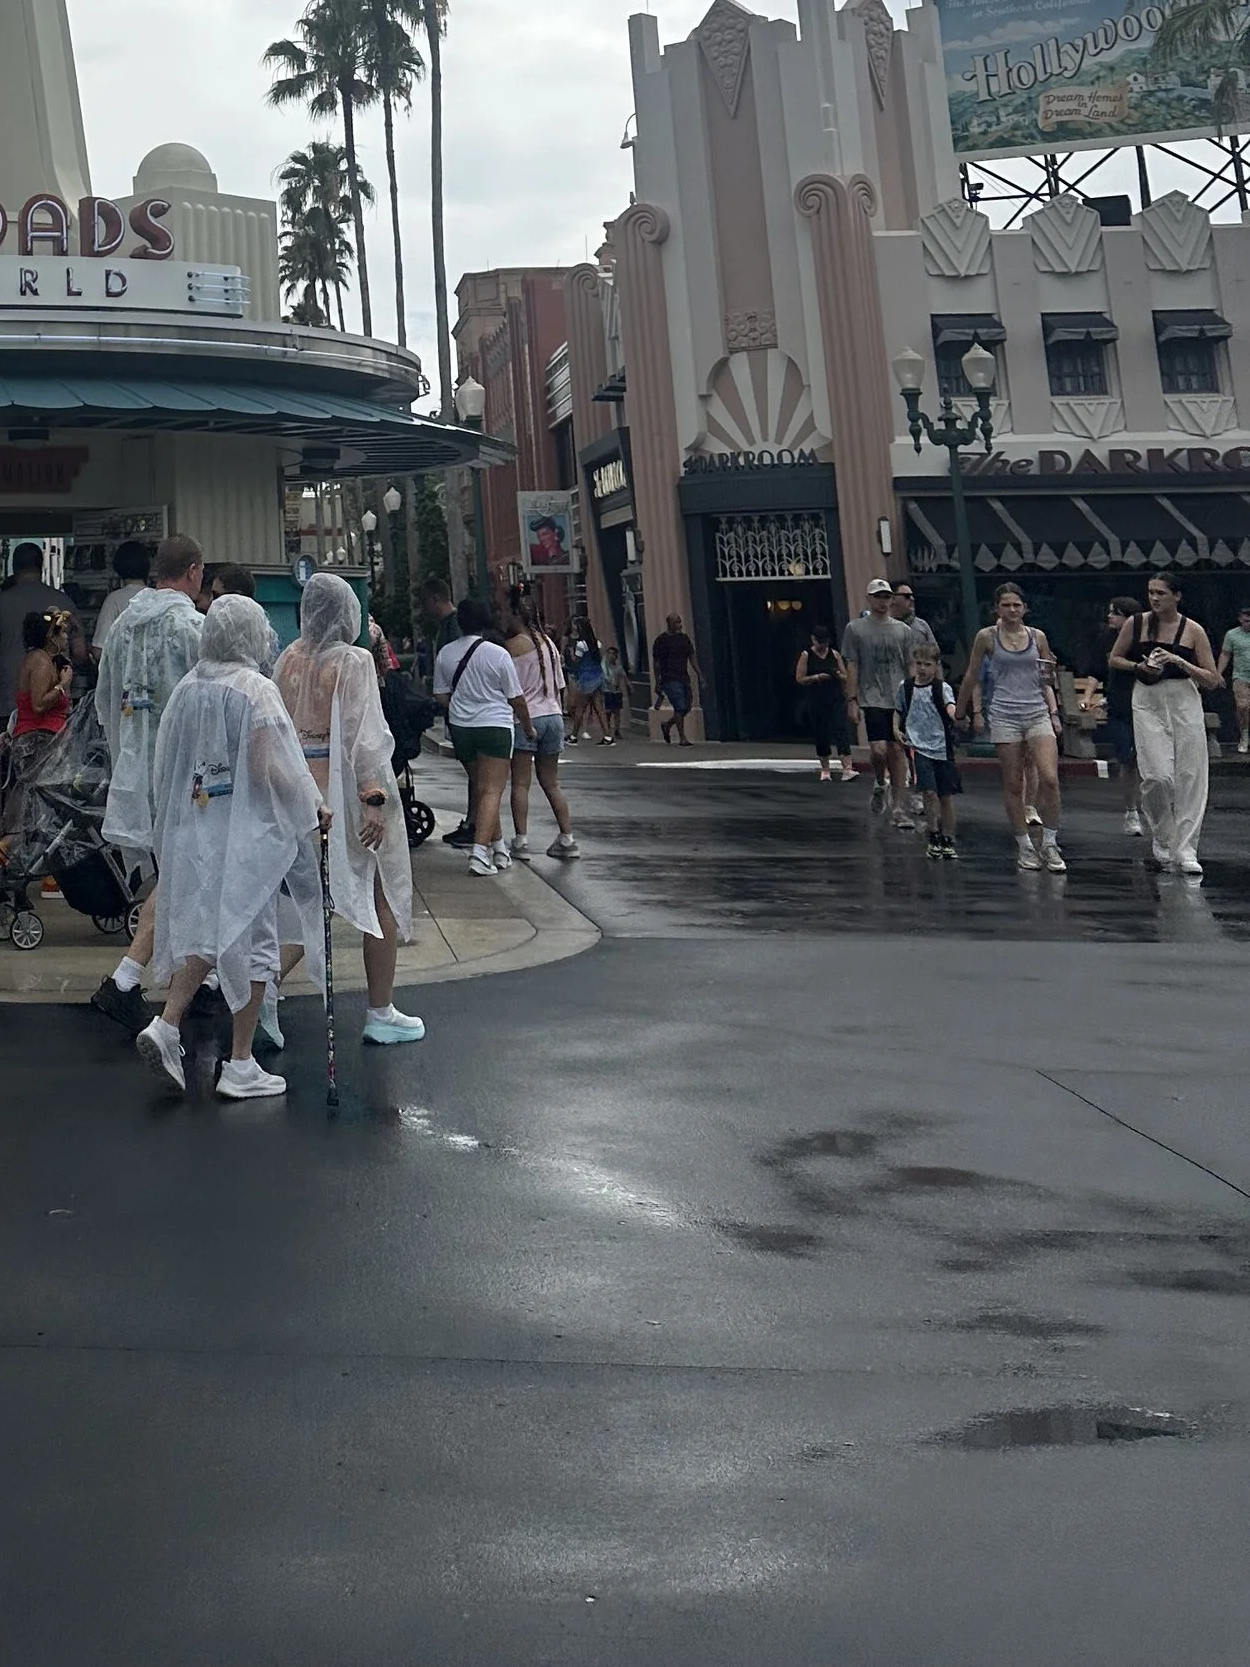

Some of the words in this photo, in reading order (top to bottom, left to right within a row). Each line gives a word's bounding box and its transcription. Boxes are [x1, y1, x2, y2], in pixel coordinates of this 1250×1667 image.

[963, 0, 1177, 104] Hollywoo
[1045, 94, 1085, 106] Dream
[1087, 90, 1123, 104] Homes
[1077, 100, 1088, 109] in
[1043, 108, 1082, 120] Dream
[1083, 104, 1118, 120] Land
